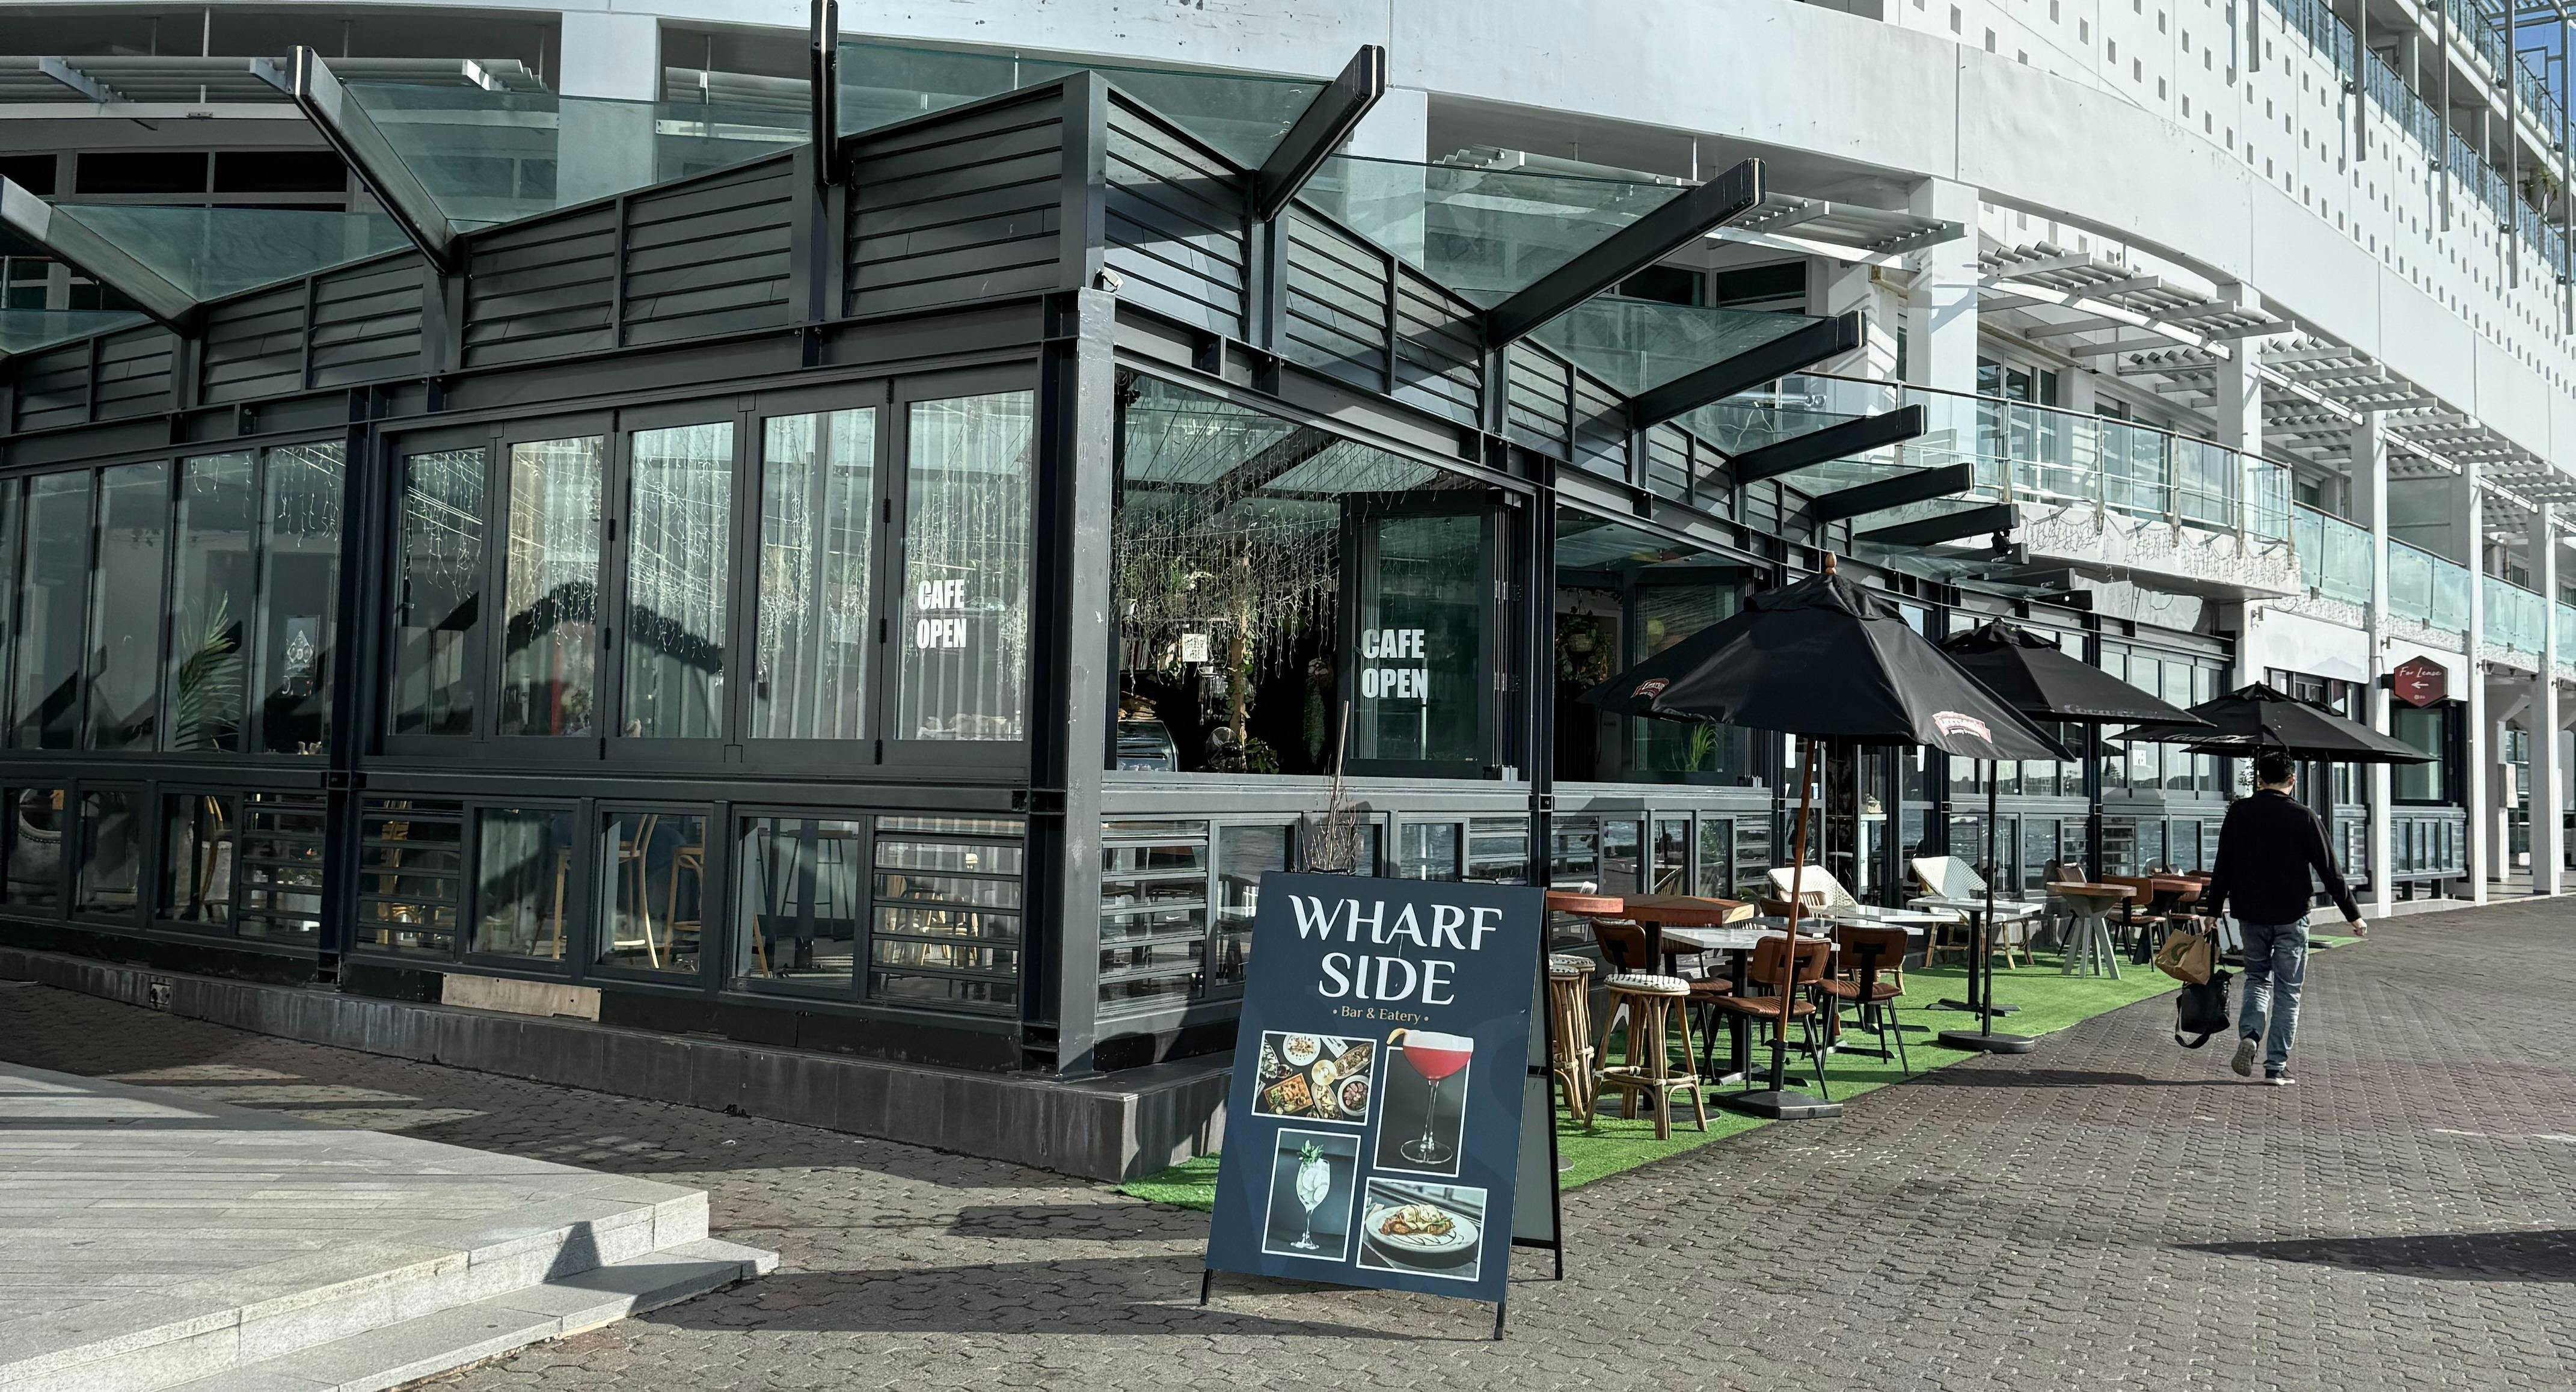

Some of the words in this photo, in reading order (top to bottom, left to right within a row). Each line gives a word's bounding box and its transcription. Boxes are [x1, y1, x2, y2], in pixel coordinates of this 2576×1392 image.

[918, 579, 965, 610] CAFE
[916, 618, 967, 649] OPEN
[1363, 629, 1424, 658] CAFE
[1362, 668, 1428, 698] OPEN
[2399, 666, 2414, 677] For
[2416, 667, 2443, 678] Lease
[1289, 895, 1503, 951] WHARF
[1319, 952, 1455, 1005] SIDE
[1342, 1005, 1363, 1018] Bar
[1366, 1007, 1375, 1019] &
[1379, 1008, 1421, 1025] Eatery
